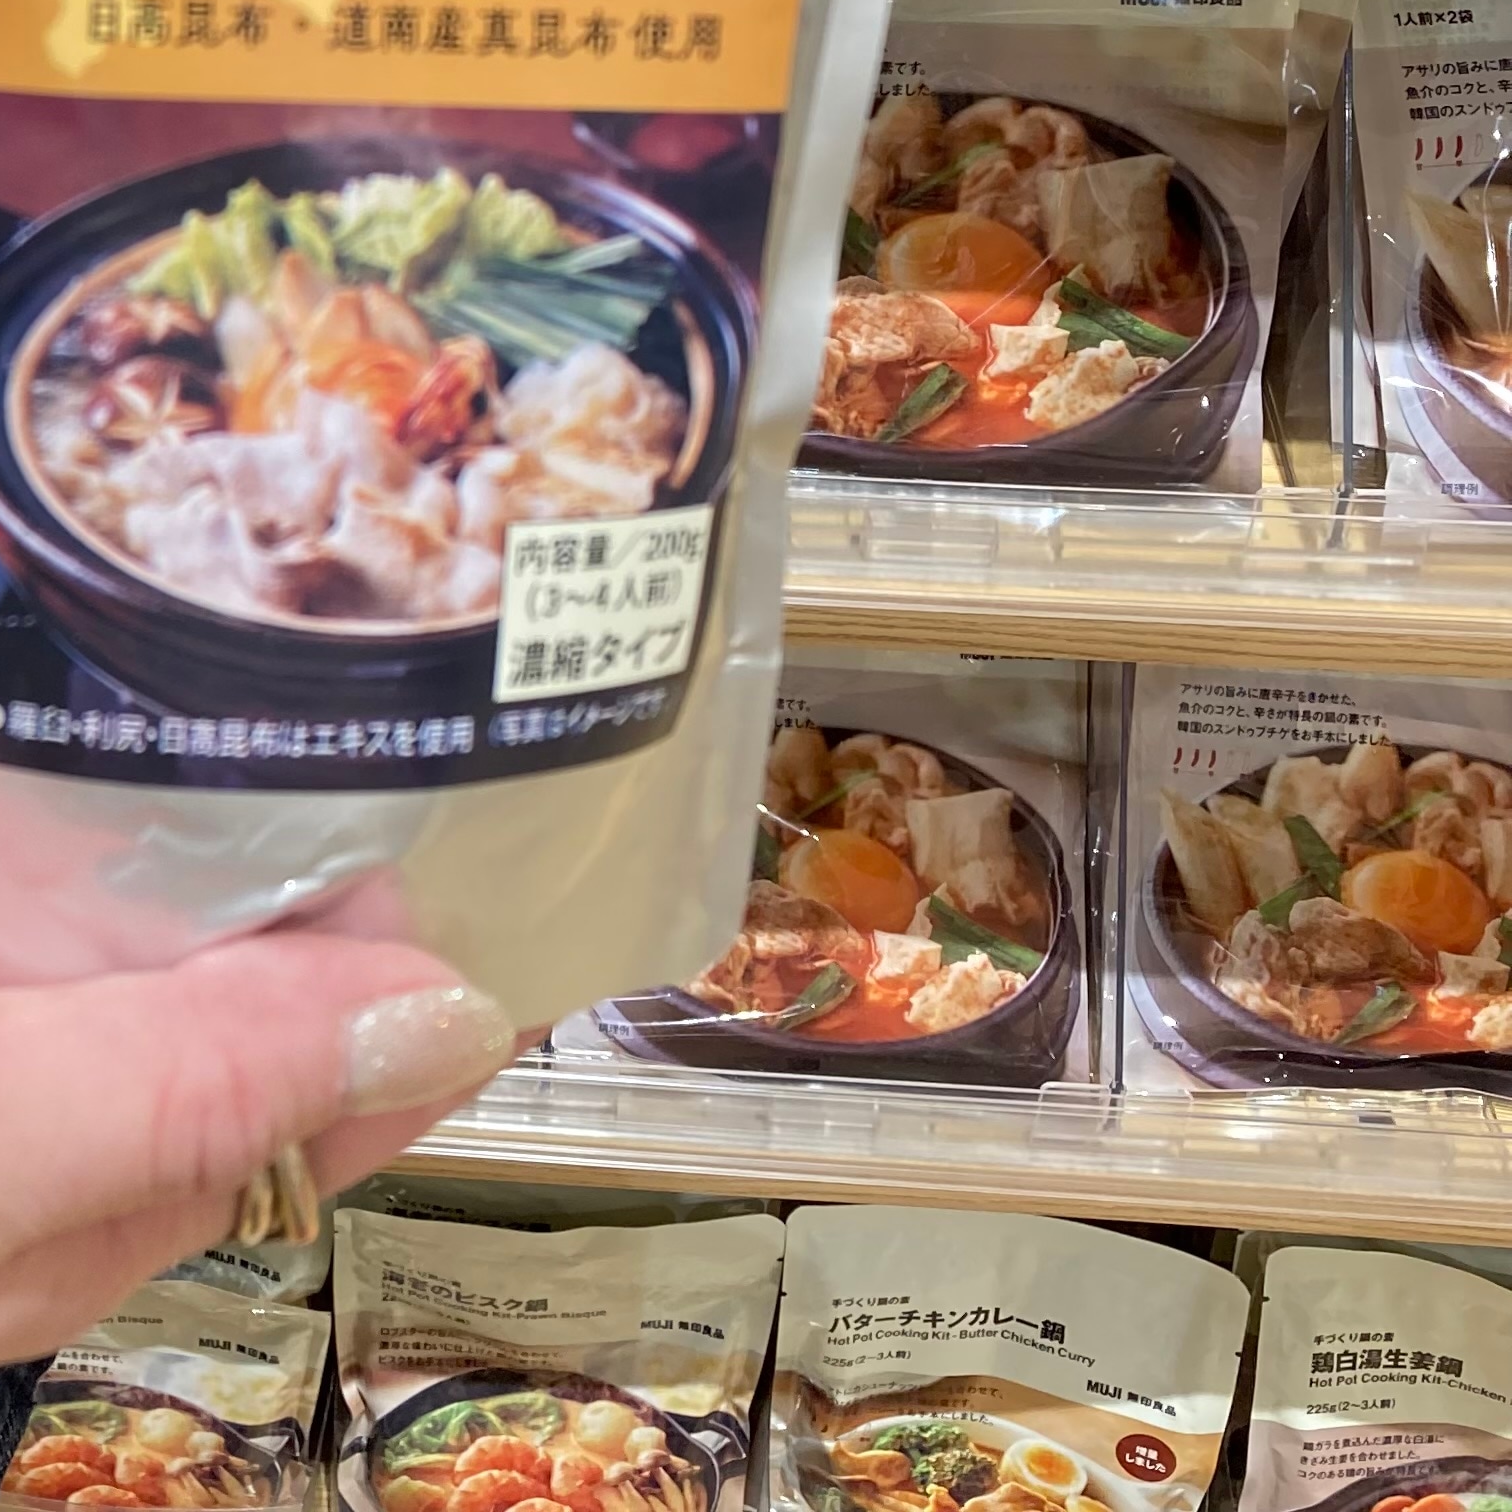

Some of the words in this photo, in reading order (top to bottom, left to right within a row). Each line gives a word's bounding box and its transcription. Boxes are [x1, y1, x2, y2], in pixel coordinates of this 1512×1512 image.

[1393, 8, 1474, 27] 1人前×2袋
[508, 619, 687, 688] 濃縮タイプ
[117, 1315, 164, 1325] Bisque
[828, 1305, 1066, 1345] バターチキンカレー鍋
[827, 1335, 850, 1347] Hot
[852, 1332, 873, 1344] Pot
[875, 1328, 929, 1341] Cooking
[1000, 1328, 1056, 1356] Chicken
[1057, 1346, 1096, 1368] Curry
[1310, 1348, 1464, 1378] 鶏白湯生姜鍋
[1086, 1379, 1123, 1400] MUJI
[1309, 1376, 1333, 1388] Hot
[1336, 1374, 1358, 1386] Pot
[1361, 1372, 1418, 1385] Cooking
[1125, 1452, 1167, 1473] しました
